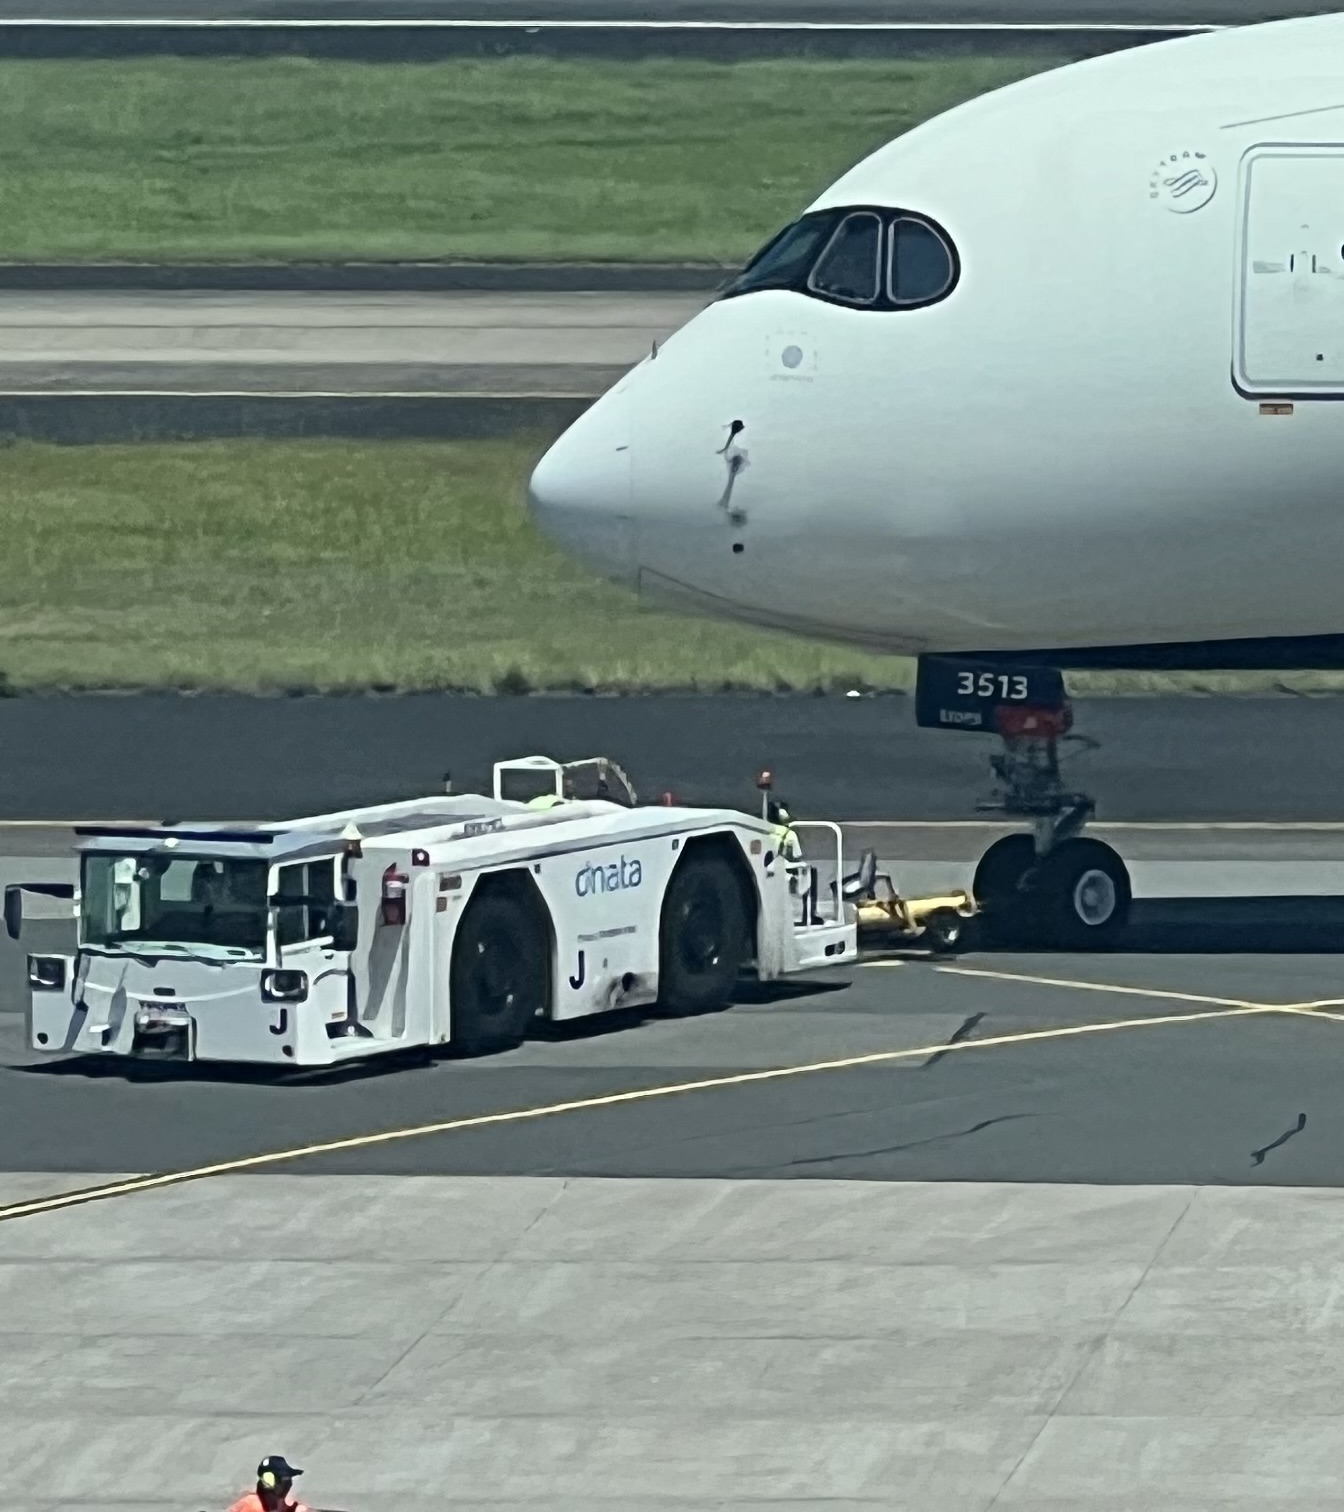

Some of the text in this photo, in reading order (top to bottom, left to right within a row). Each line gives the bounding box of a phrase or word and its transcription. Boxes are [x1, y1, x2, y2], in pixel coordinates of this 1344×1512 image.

[957, 672, 1028, 699] 3513
[575, 855, 642, 897] dnata
[569, 950, 585, 990] J
[269, 1008, 288, 1035] J
